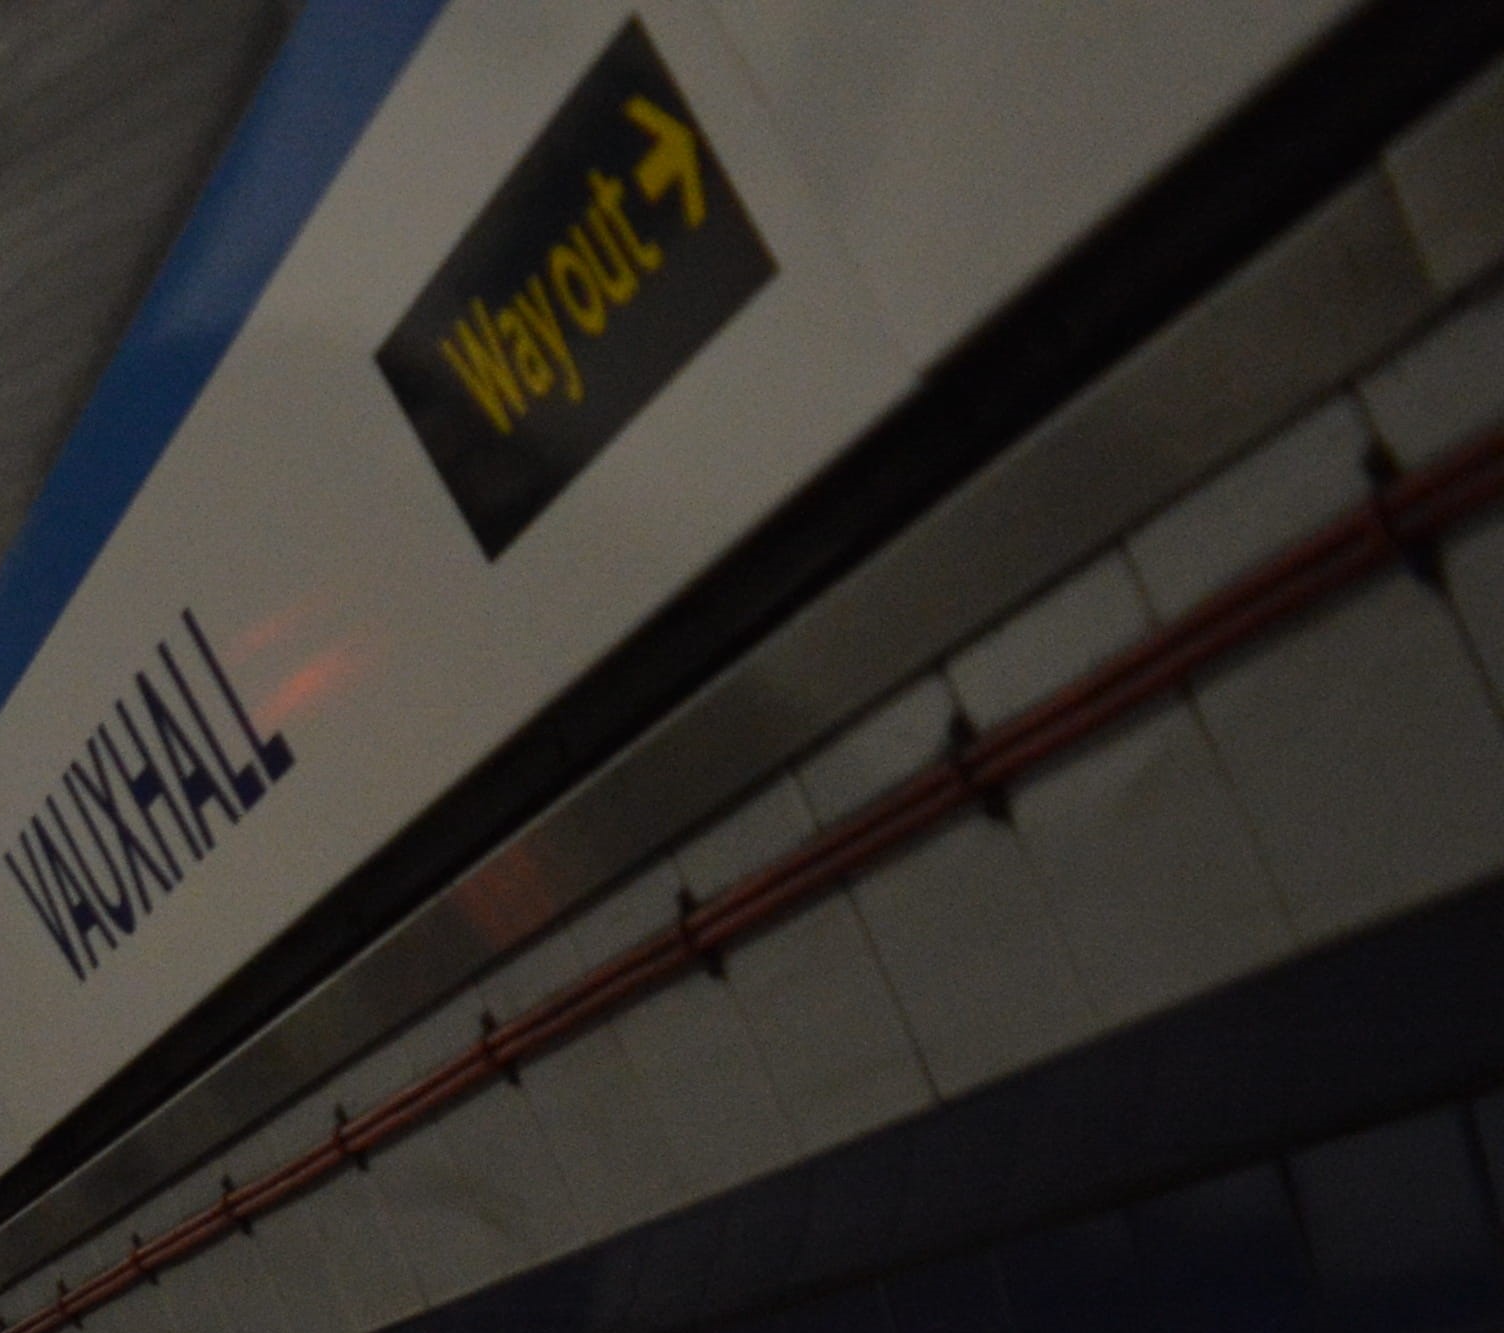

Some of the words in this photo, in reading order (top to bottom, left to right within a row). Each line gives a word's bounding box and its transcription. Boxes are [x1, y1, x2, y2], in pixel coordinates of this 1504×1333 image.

[442, 276, 583, 436] Way
[548, 168, 665, 338] out
[2, 602, 299, 985] VAUXHALL
